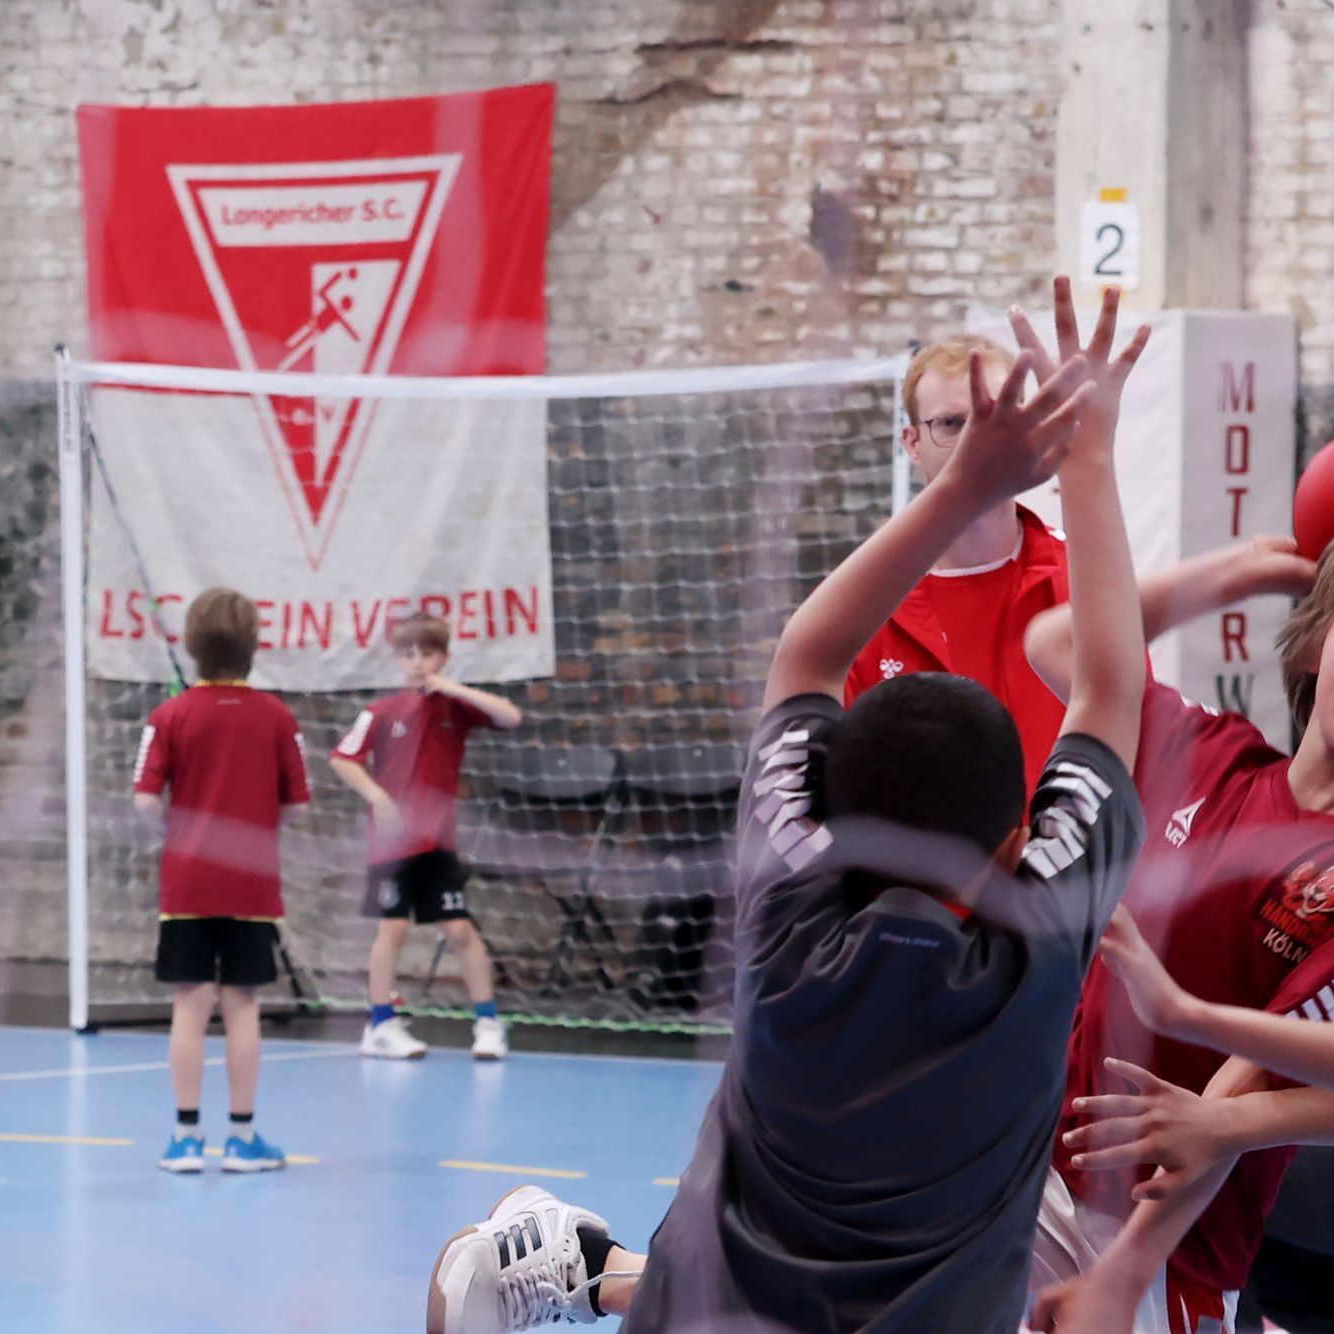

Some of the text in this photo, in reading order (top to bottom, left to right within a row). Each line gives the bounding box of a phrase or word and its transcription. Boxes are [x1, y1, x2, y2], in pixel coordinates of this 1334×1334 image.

[221, 202, 354, 231] Longericher
[1094, 223, 1124, 276] 2
[1263, 927, 1308, 963] KÖLN
